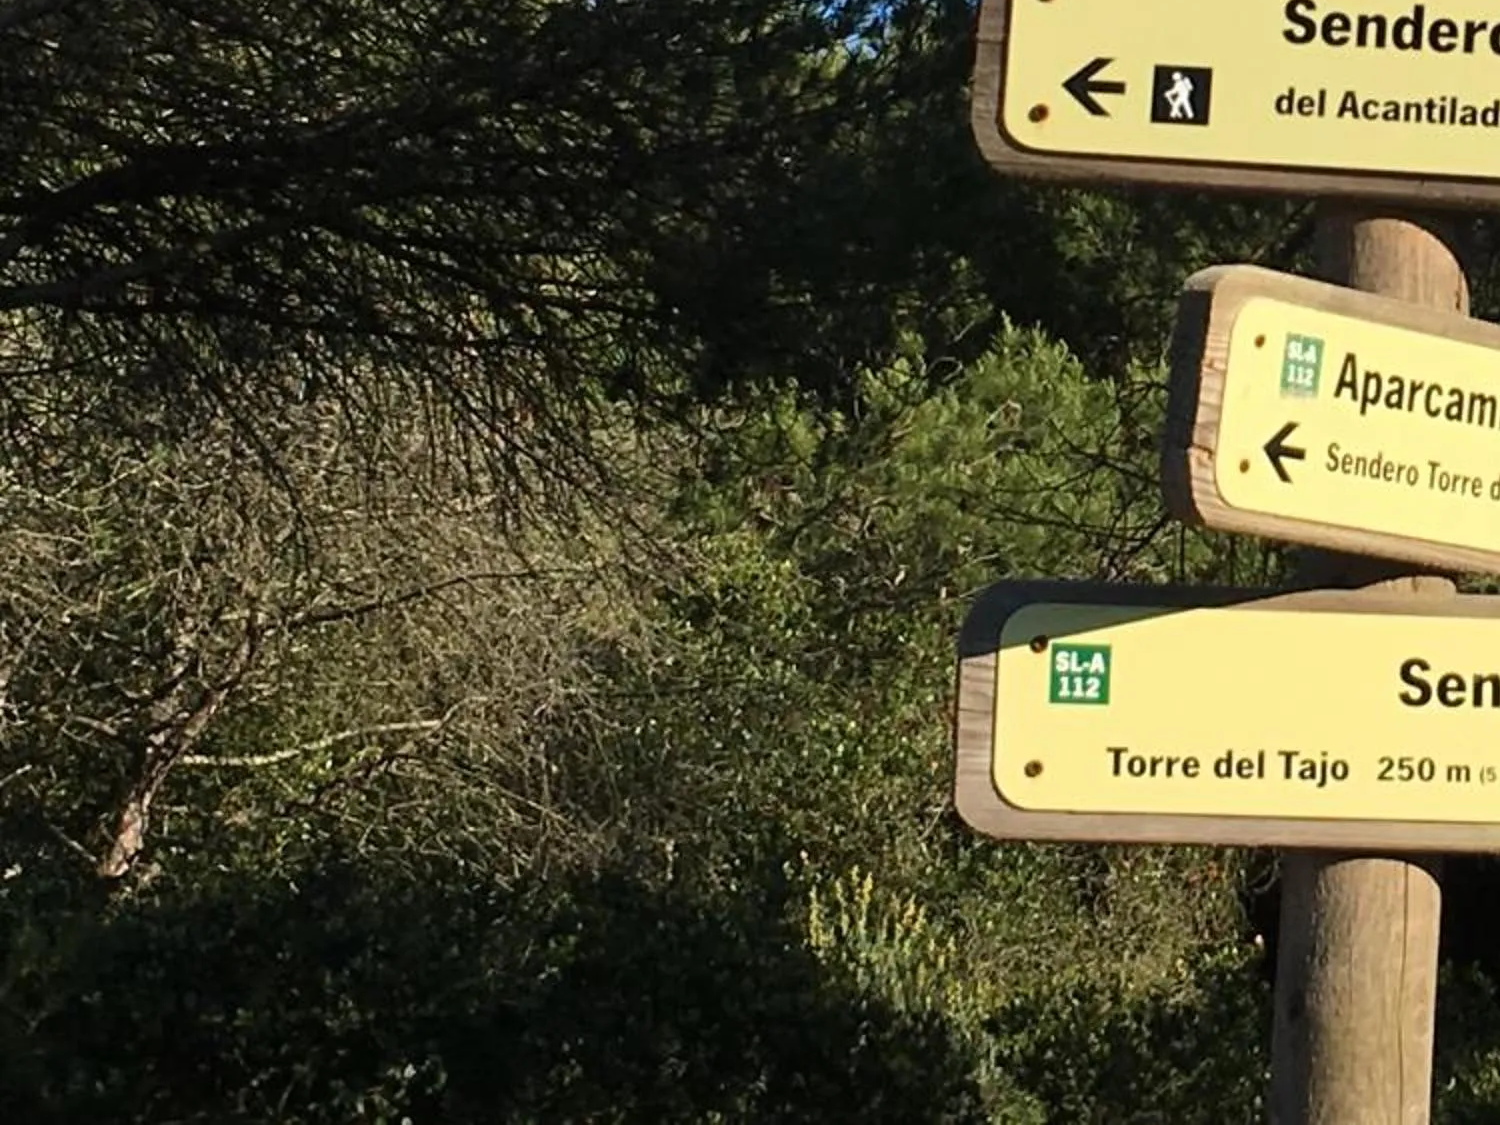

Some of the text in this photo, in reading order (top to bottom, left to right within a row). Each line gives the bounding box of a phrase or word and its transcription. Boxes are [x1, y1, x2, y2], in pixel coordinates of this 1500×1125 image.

[1274, 86, 1327, 118] del
[1287, 364, 1315, 386] 112
[1325, 442, 1419, 487] Sendero
[1427, 460, 1483, 498] Torre
[1055, 650, 1105, 673] SL-A
[1058, 676, 1101, 698] 112
[1106, 746, 1201, 778] Torre
[1213, 749, 1265, 780] del
[1277, 750, 1349, 788] Tajo
[1377, 756, 1436, 782] 250
[1446, 765, 1471, 783] m
[1479, 766, 1497, 785] (5
